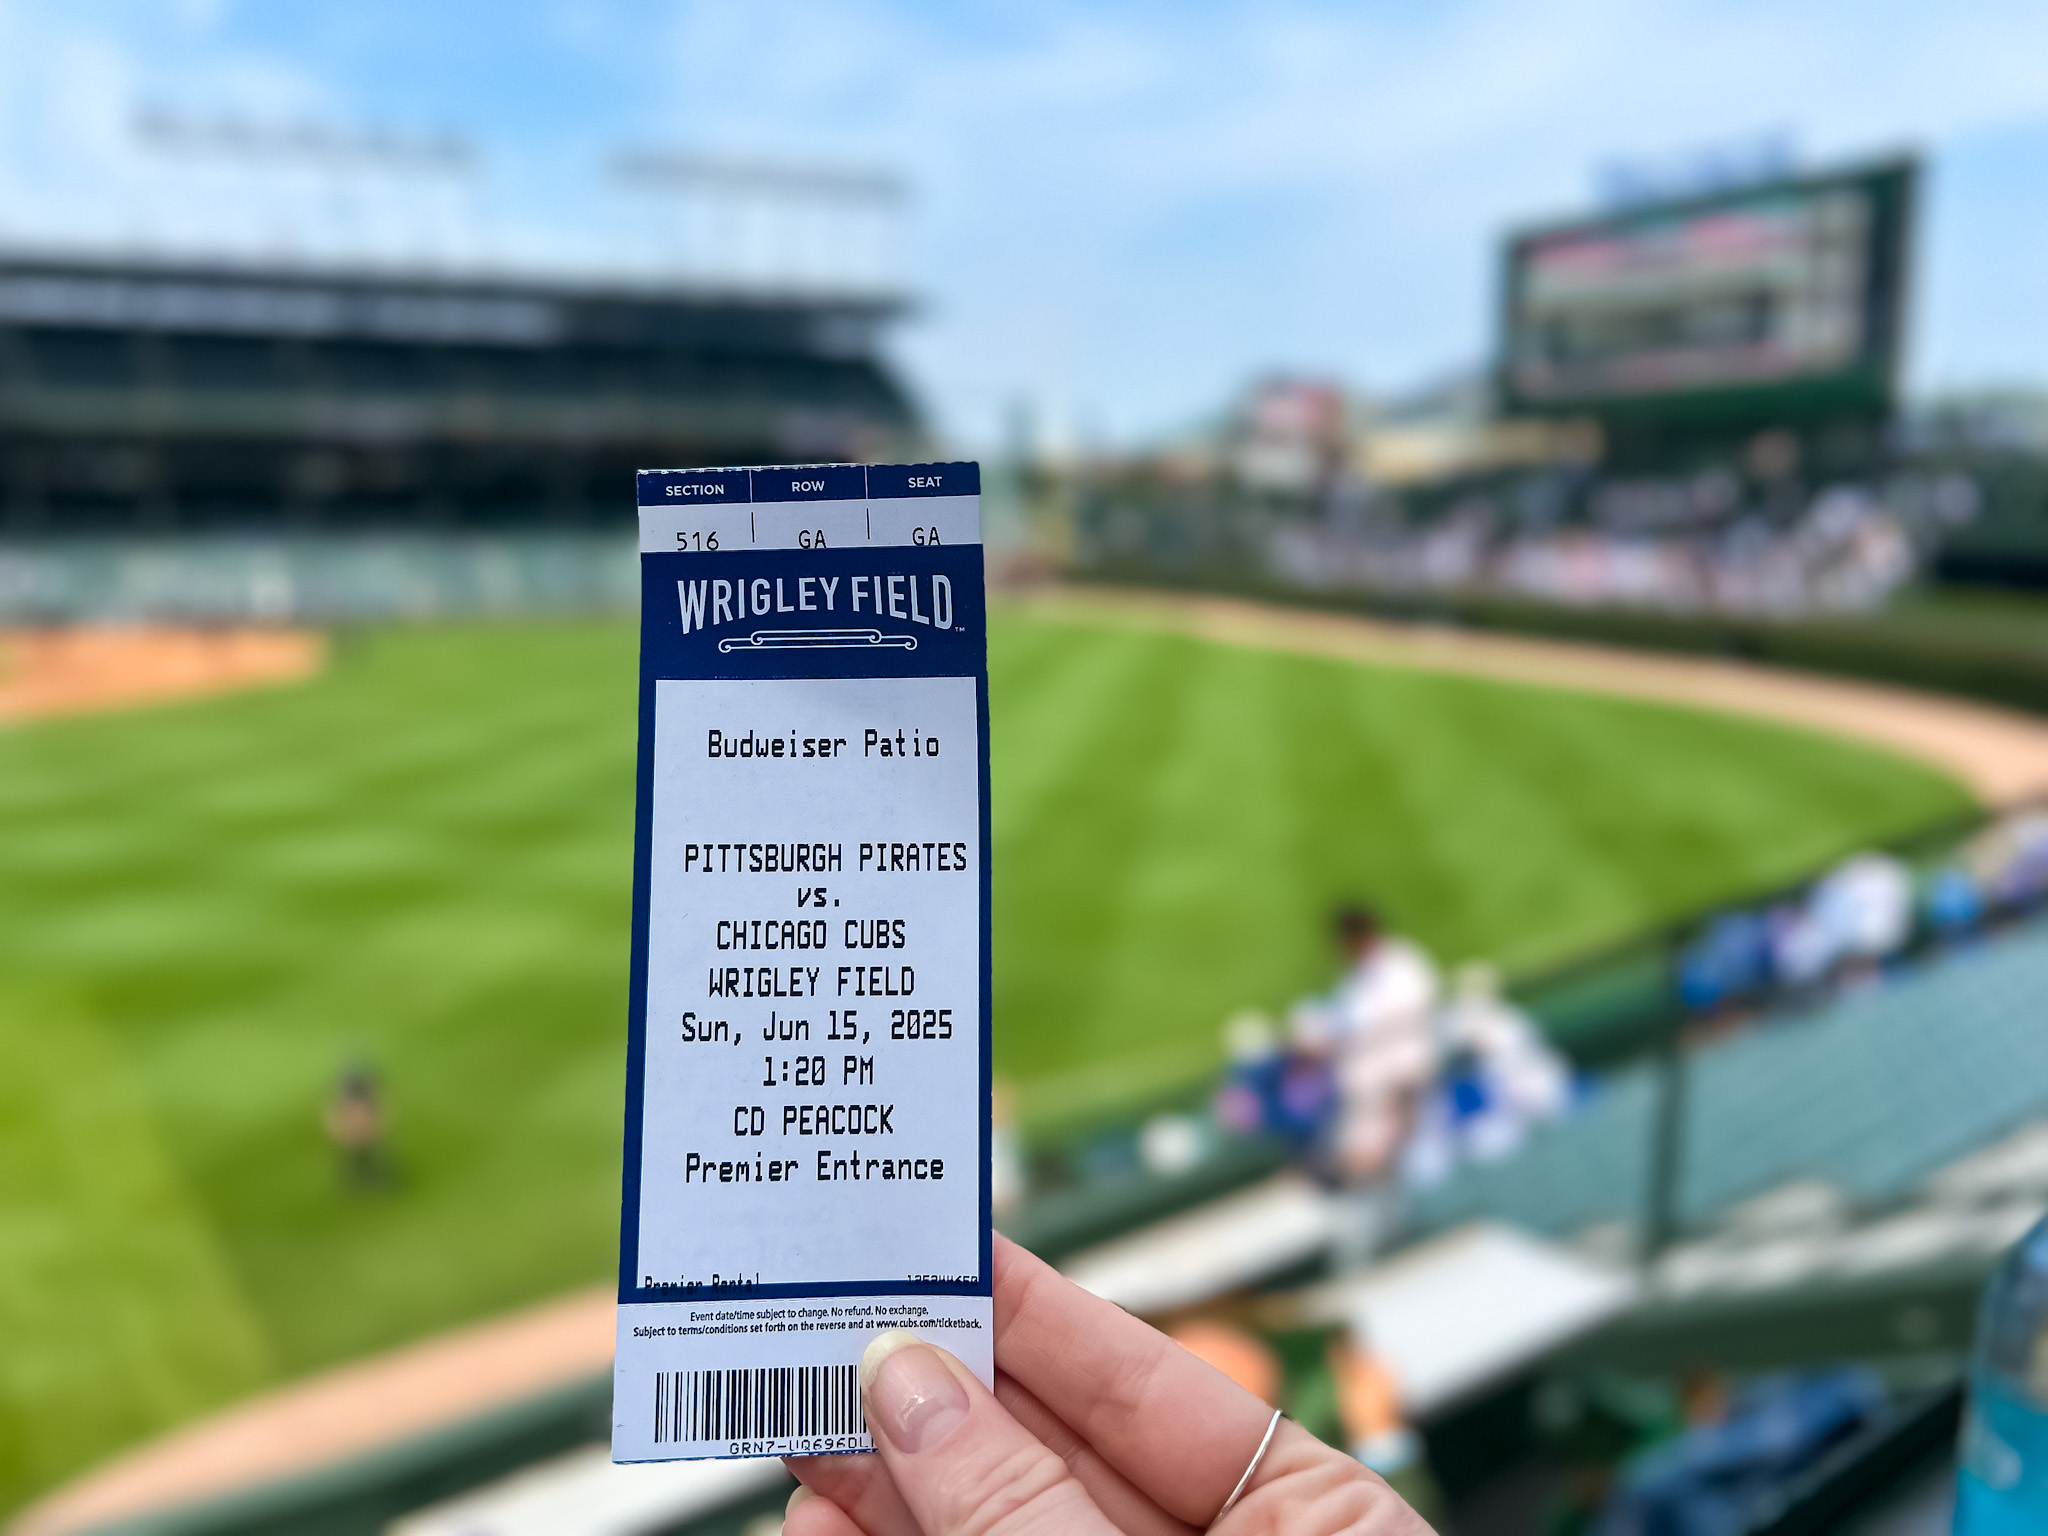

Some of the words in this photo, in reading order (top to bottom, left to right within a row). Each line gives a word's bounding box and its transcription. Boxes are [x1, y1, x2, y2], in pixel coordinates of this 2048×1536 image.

[665, 484, 725, 497] SECTION
[791, 480, 825, 493] ROW
[908, 476, 942, 488] SEAT
[676, 531, 719, 551] 516
[798, 530, 827, 549] GA
[912, 527, 941, 546] GA
[677, 576, 840, 635] WRIGLEY
[851, 574, 953, 630] FIELD
[708, 730, 847, 758] Budweiser
[864, 729, 940, 757] Patio
[685, 843, 842, 872] PITTSBURGH
[859, 842, 967, 871] PIRATES
[797, 887, 840, 907] vs.
[717, 920, 827, 949] CHICAGO
[844, 919, 906, 949] CUBS
[709, 967, 820, 998] WRIGLEY
[837, 966, 915, 996] FIELD
[681, 1012, 742, 1046] Sun,
[763, 1011, 809, 1041] Jun
[828, 1010, 871, 1045] 15,
[891, 1009, 952, 1039] 2025
[763, 1056, 826, 1087] 1:20
[844, 1055, 874, 1085] PM
[734, 1106, 765, 1136] CD
[783, 1104, 894, 1135] PEACOCK
[686, 1151, 799, 1183] Premier
[817, 1150, 944, 1181] Entrance
[690, 1311, 714, 1321] Event
[715, 1308, 755, 1321] date/time
[756, 1307, 787, 1320] subject
[787, 1308, 797, 1318] to
[798, 1306, 830, 1319] change.
[831, 1307, 843, 1316] No
[844, 1305, 874, 1316] refund.
[875, 1306, 887, 1315] No
[633, 1326, 665, 1339] Subject
[667, 1327, 676, 1336] to
[678, 1324, 748, 1335] terms/conditions
[750, 1324, 763, 1333] set
[764, 1322, 786, 1332] forth
[788, 1323, 799, 1331] on
[800, 1321, 814, 1331] the
[815, 1322, 846, 1330] reverse
[847, 1319, 864, 1329] and
[865, 1320, 875, 1329] at
[876, 1317, 982, 1329] www.cubs.com/ticketback.
